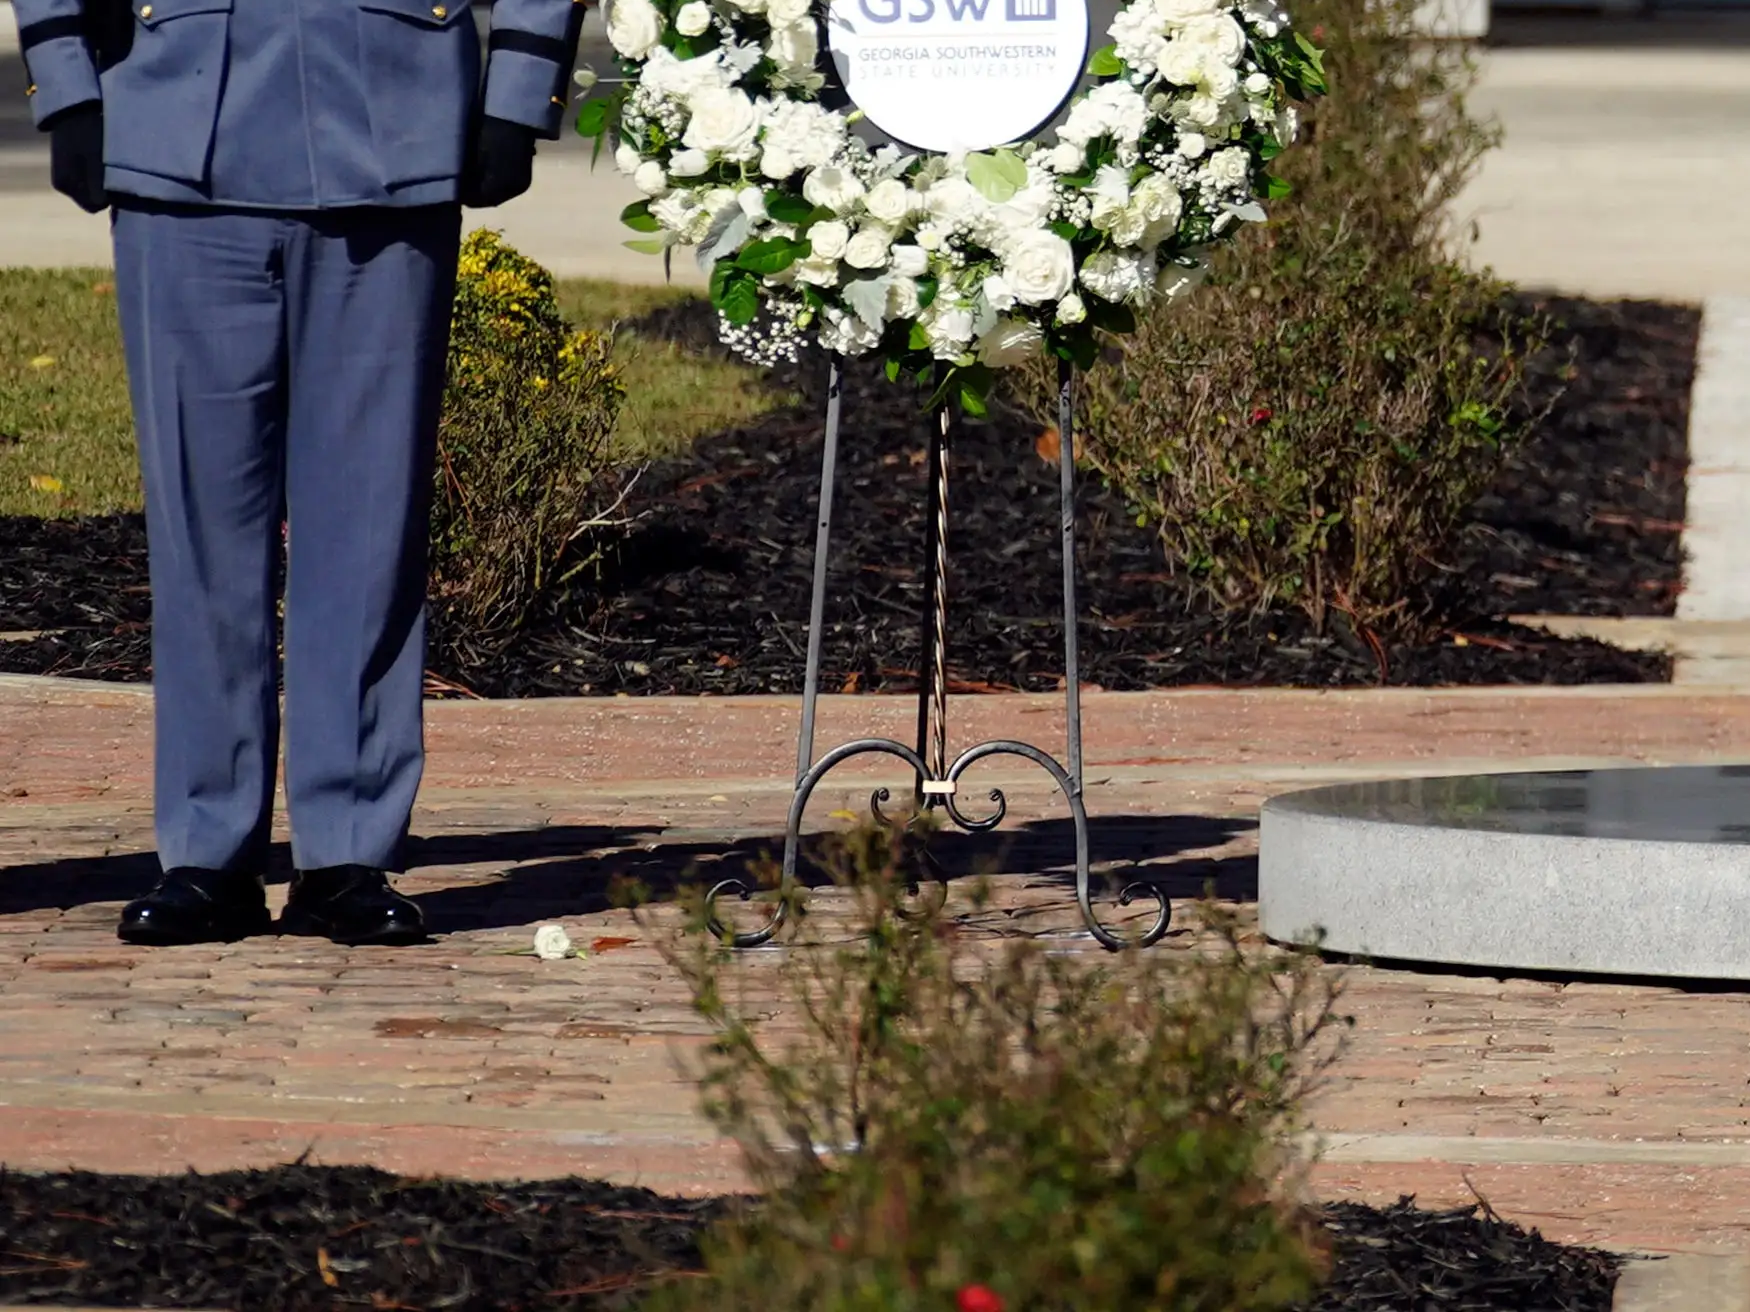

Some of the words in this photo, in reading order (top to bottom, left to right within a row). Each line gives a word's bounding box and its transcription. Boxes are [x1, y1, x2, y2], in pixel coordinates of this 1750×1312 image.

[858, 47, 930, 61] GEORGIA
[936, 45, 1056, 60] SOUTHWESTERN
[859, 65, 917, 80] STATE
[932, 63, 1056, 79] UNIVERSITY
